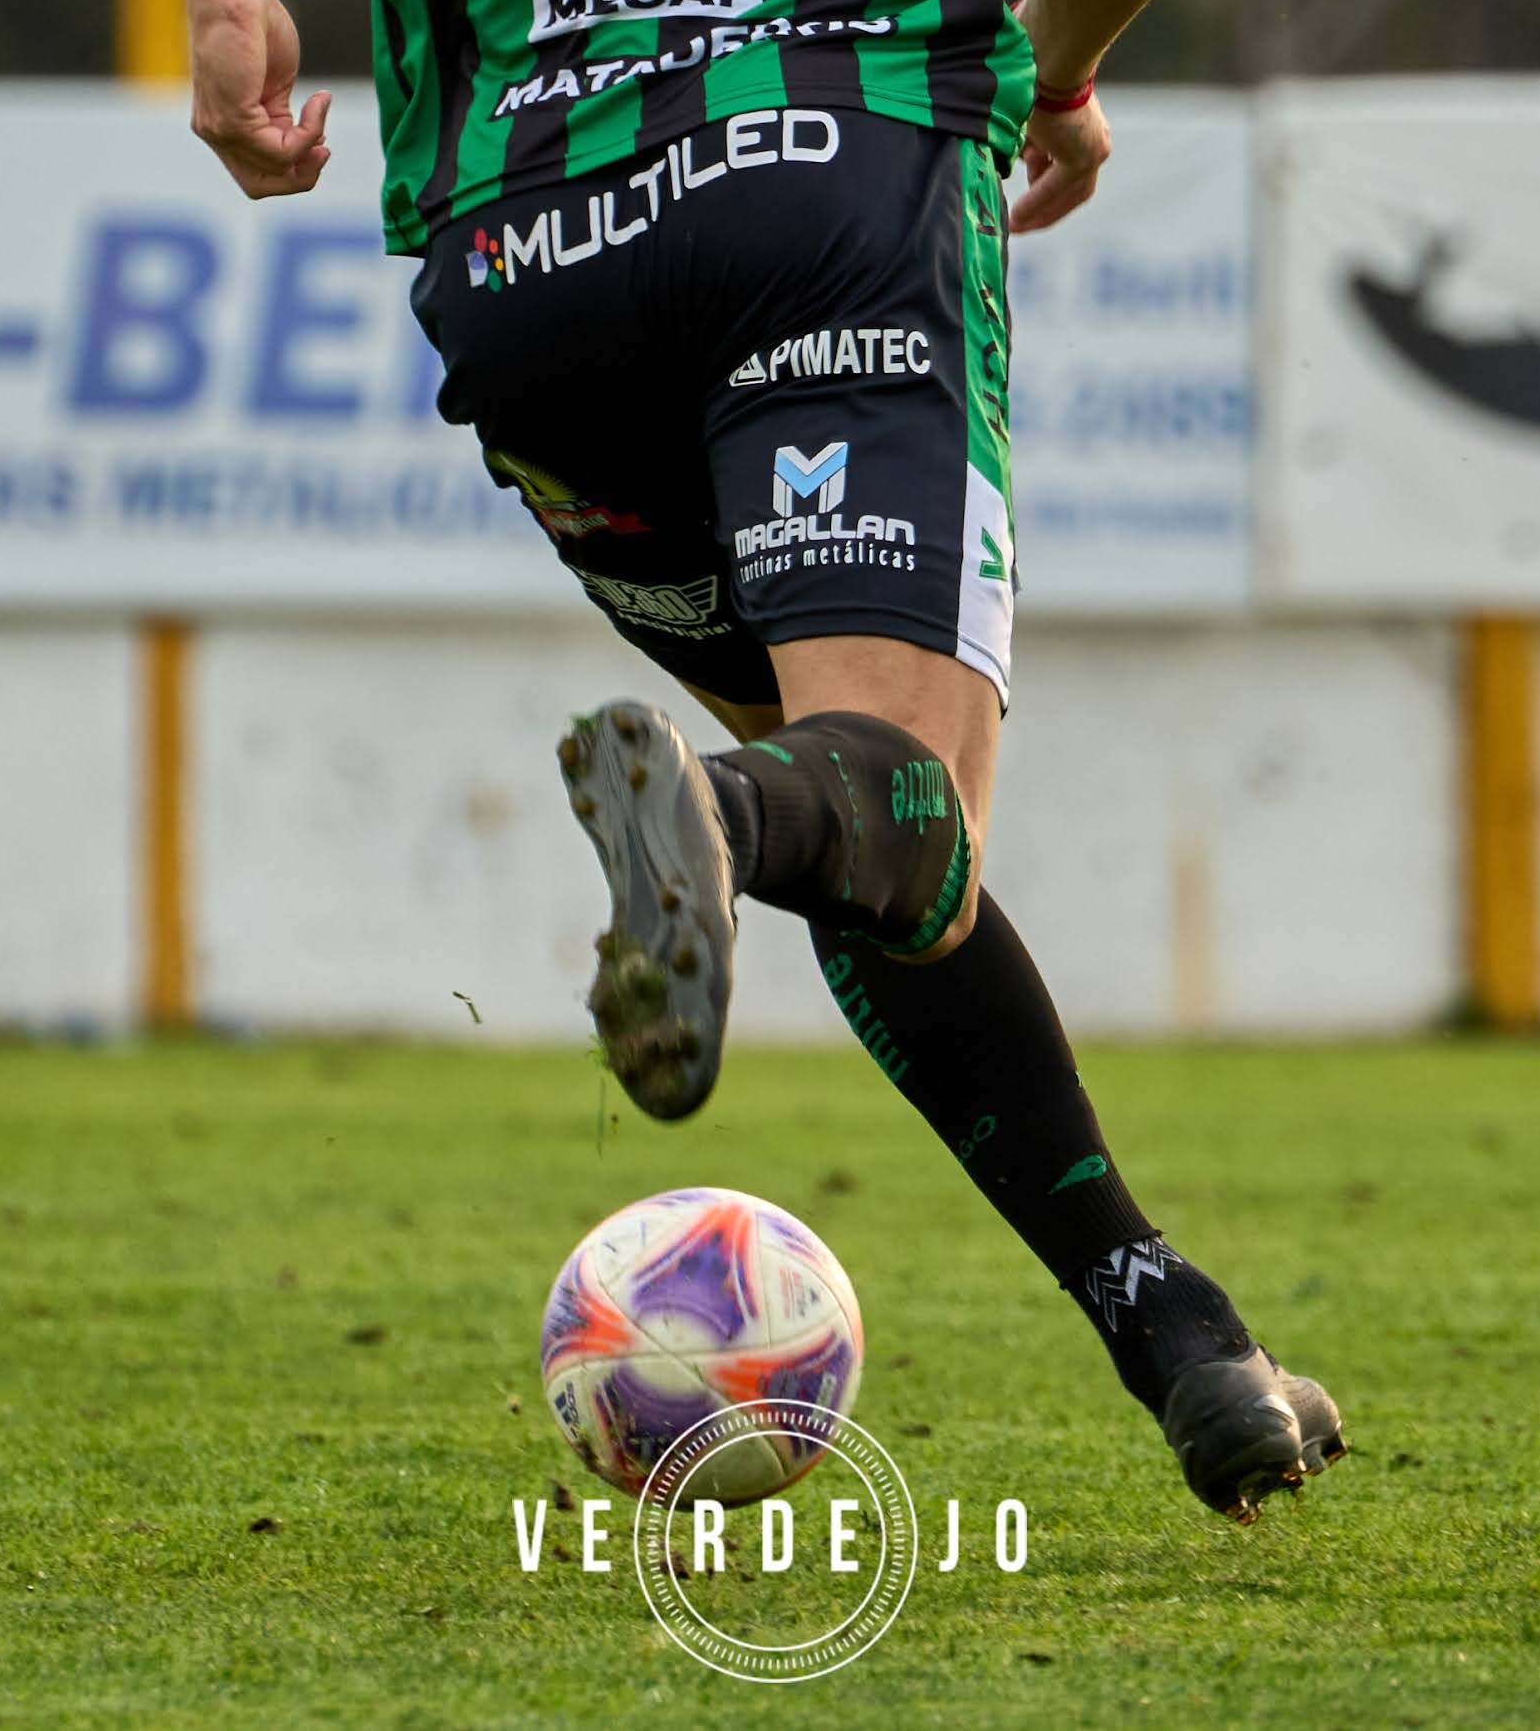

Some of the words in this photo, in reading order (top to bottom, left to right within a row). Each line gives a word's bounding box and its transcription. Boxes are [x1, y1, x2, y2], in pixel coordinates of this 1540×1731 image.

[502, 109, 841, 285] MULTILED
[770, 328, 931, 384] PIMATEC
[735, 514, 916, 559] MAGALLAN
[803, 539, 916, 572] metálicas
